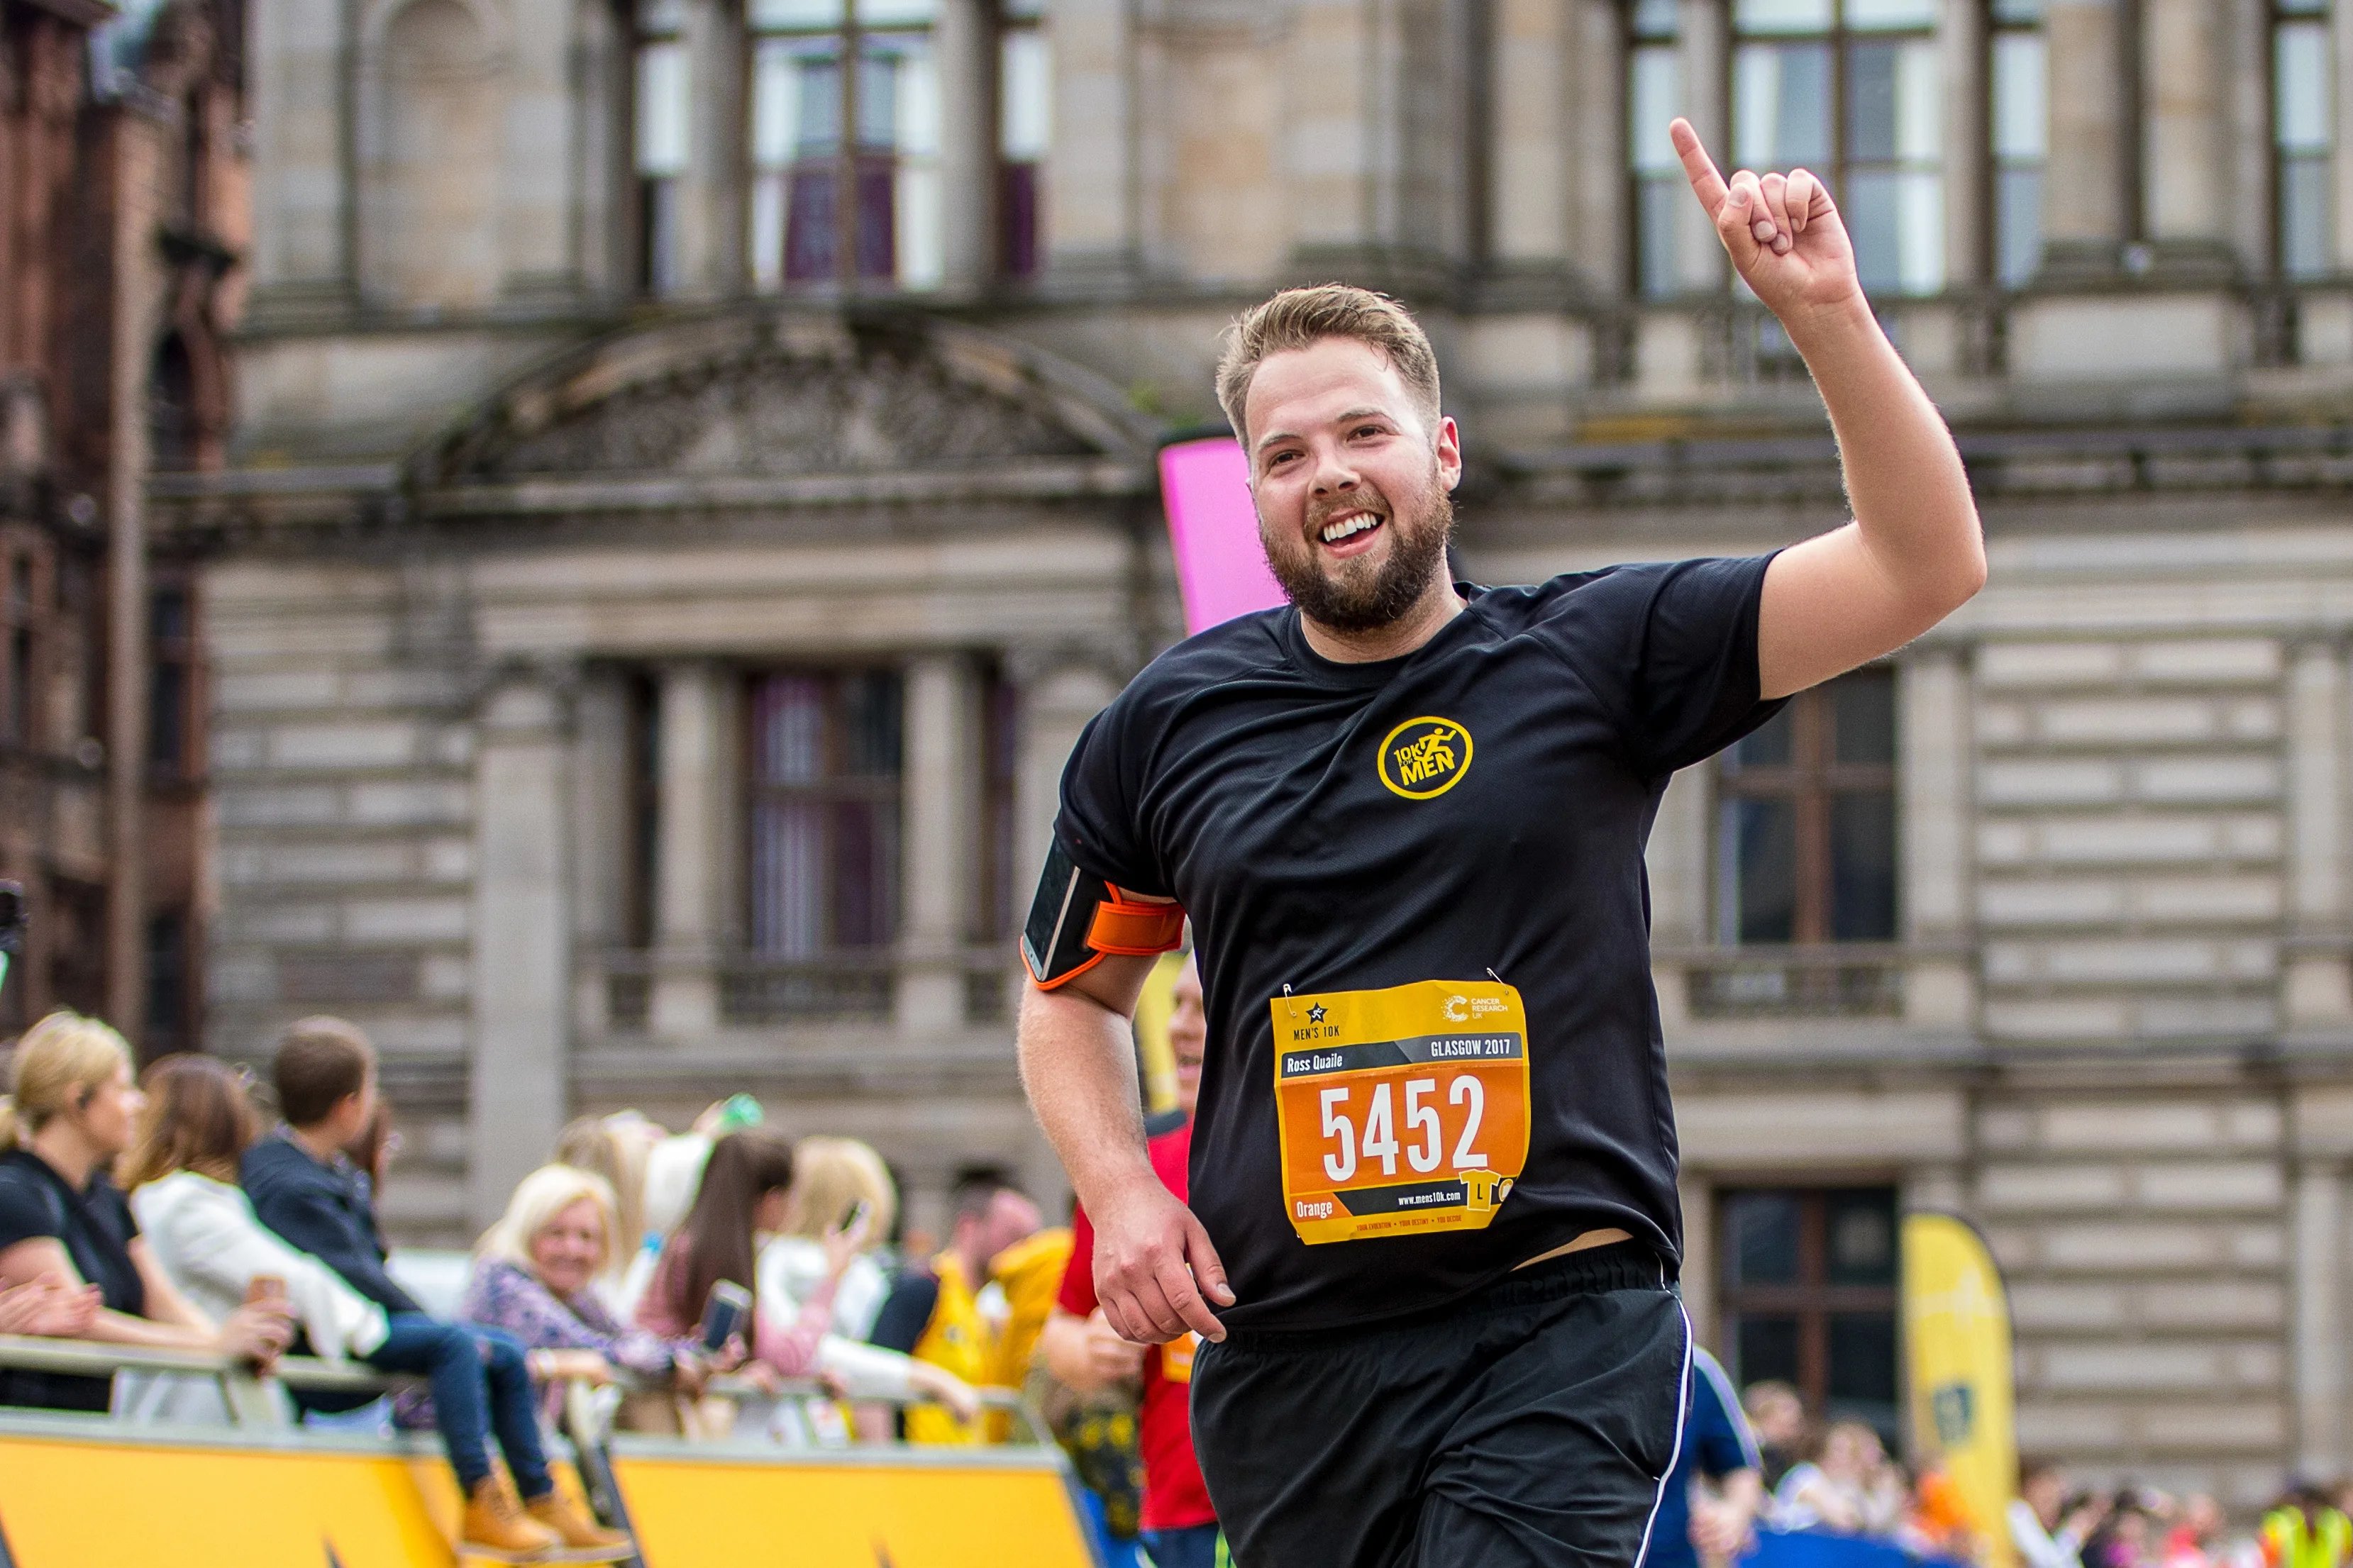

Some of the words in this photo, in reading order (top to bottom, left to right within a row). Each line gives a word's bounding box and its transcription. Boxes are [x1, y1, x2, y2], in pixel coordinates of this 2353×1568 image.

[1394, 743, 1422, 762] 10K
[1400, 752, 1455, 786] MEN
[1293, 1027, 1319, 1040] MEN'S
[1324, 1025, 1339, 1038] 10K
[1431, 1040, 1481, 1057] GLASGOW
[1485, 1039, 1510, 1055] 2017
[1287, 1057, 1311, 1073] Ross
[1313, 1052, 1343, 1071] Quaile
[1319, 1074, 1488, 1182] 5452
[1398, 1191, 1461, 1206] www.mens10k.com
[1477, 1183, 1483, 1200] L
[1296, 1201, 1333, 1219] Orange
